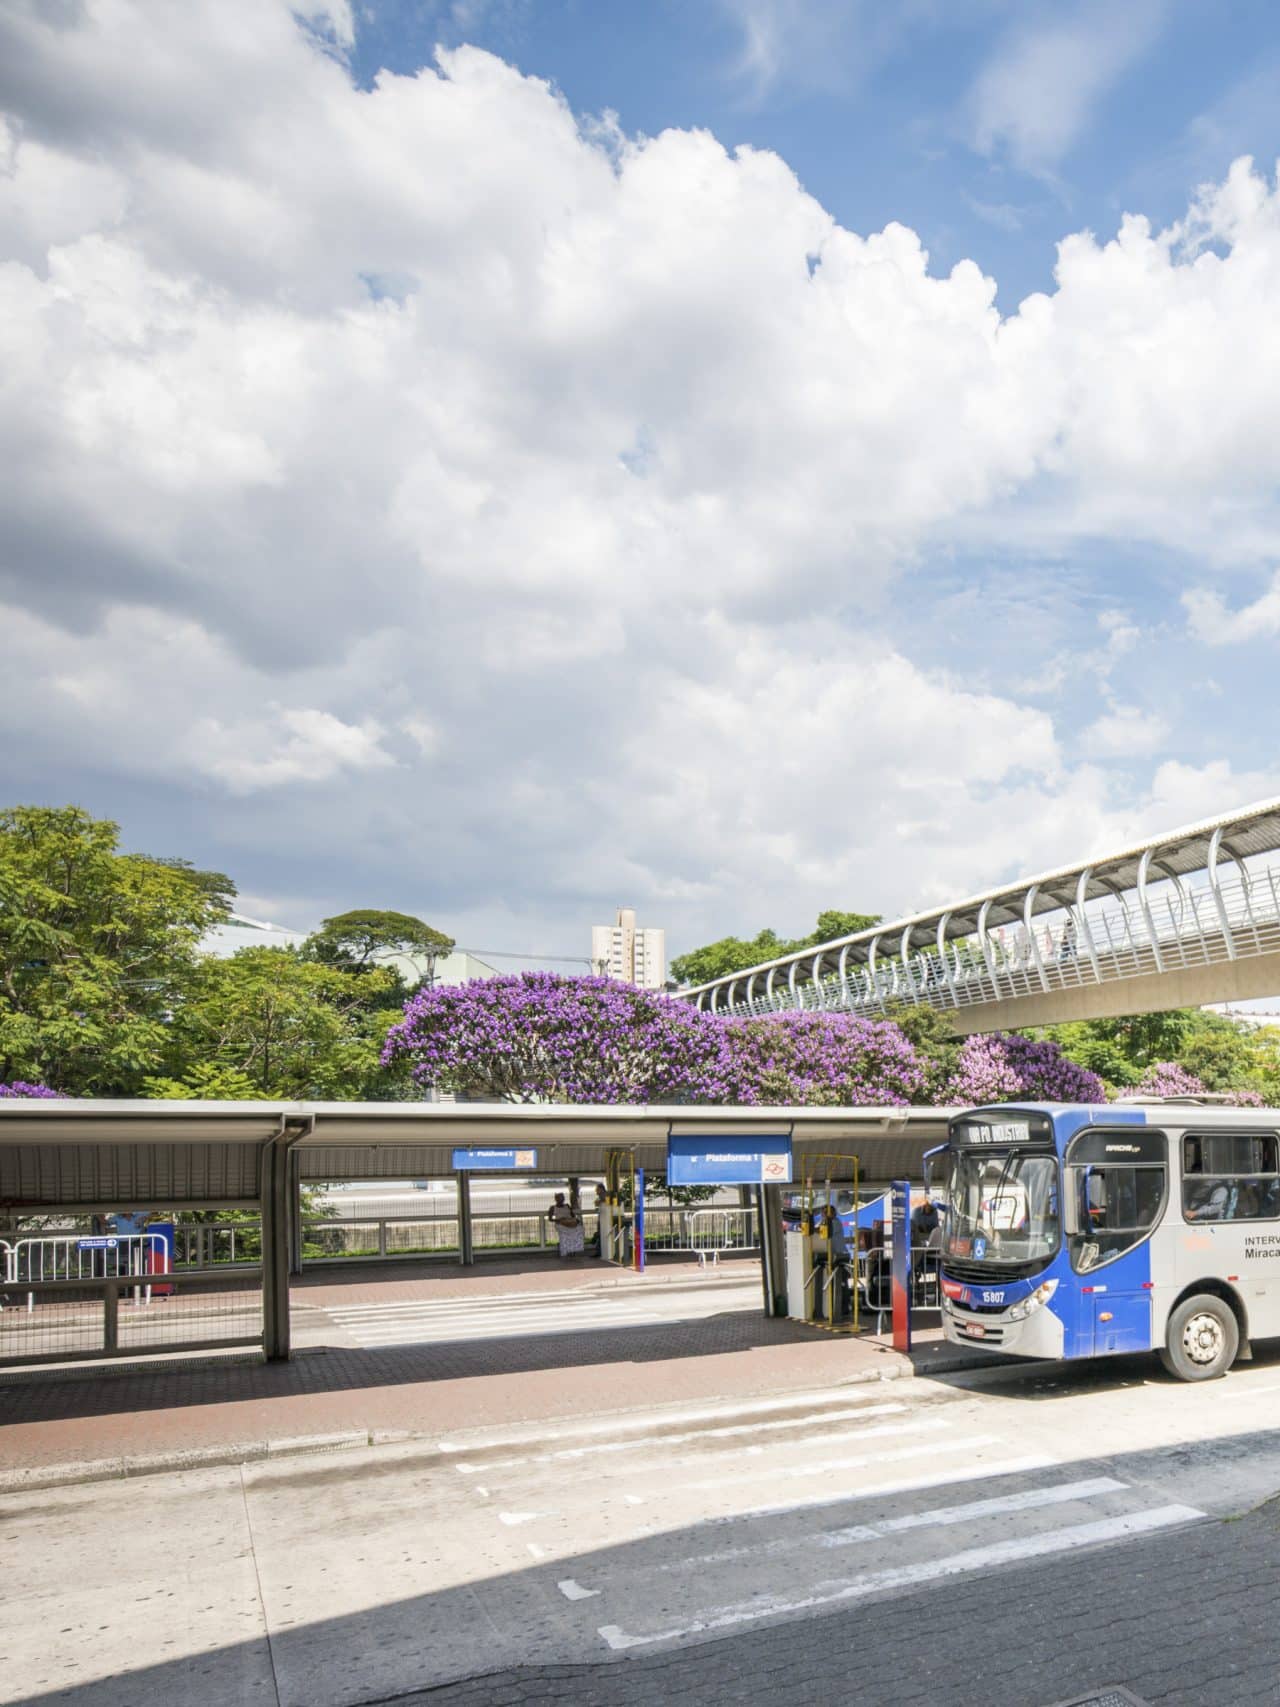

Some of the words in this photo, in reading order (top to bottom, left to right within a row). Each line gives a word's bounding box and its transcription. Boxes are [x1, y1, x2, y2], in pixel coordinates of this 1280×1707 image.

[705, 1153, 752, 1162] Plataforma
[754, 1153, 758, 1161] 1
[982, 1291, 1005, 1303] 15807
